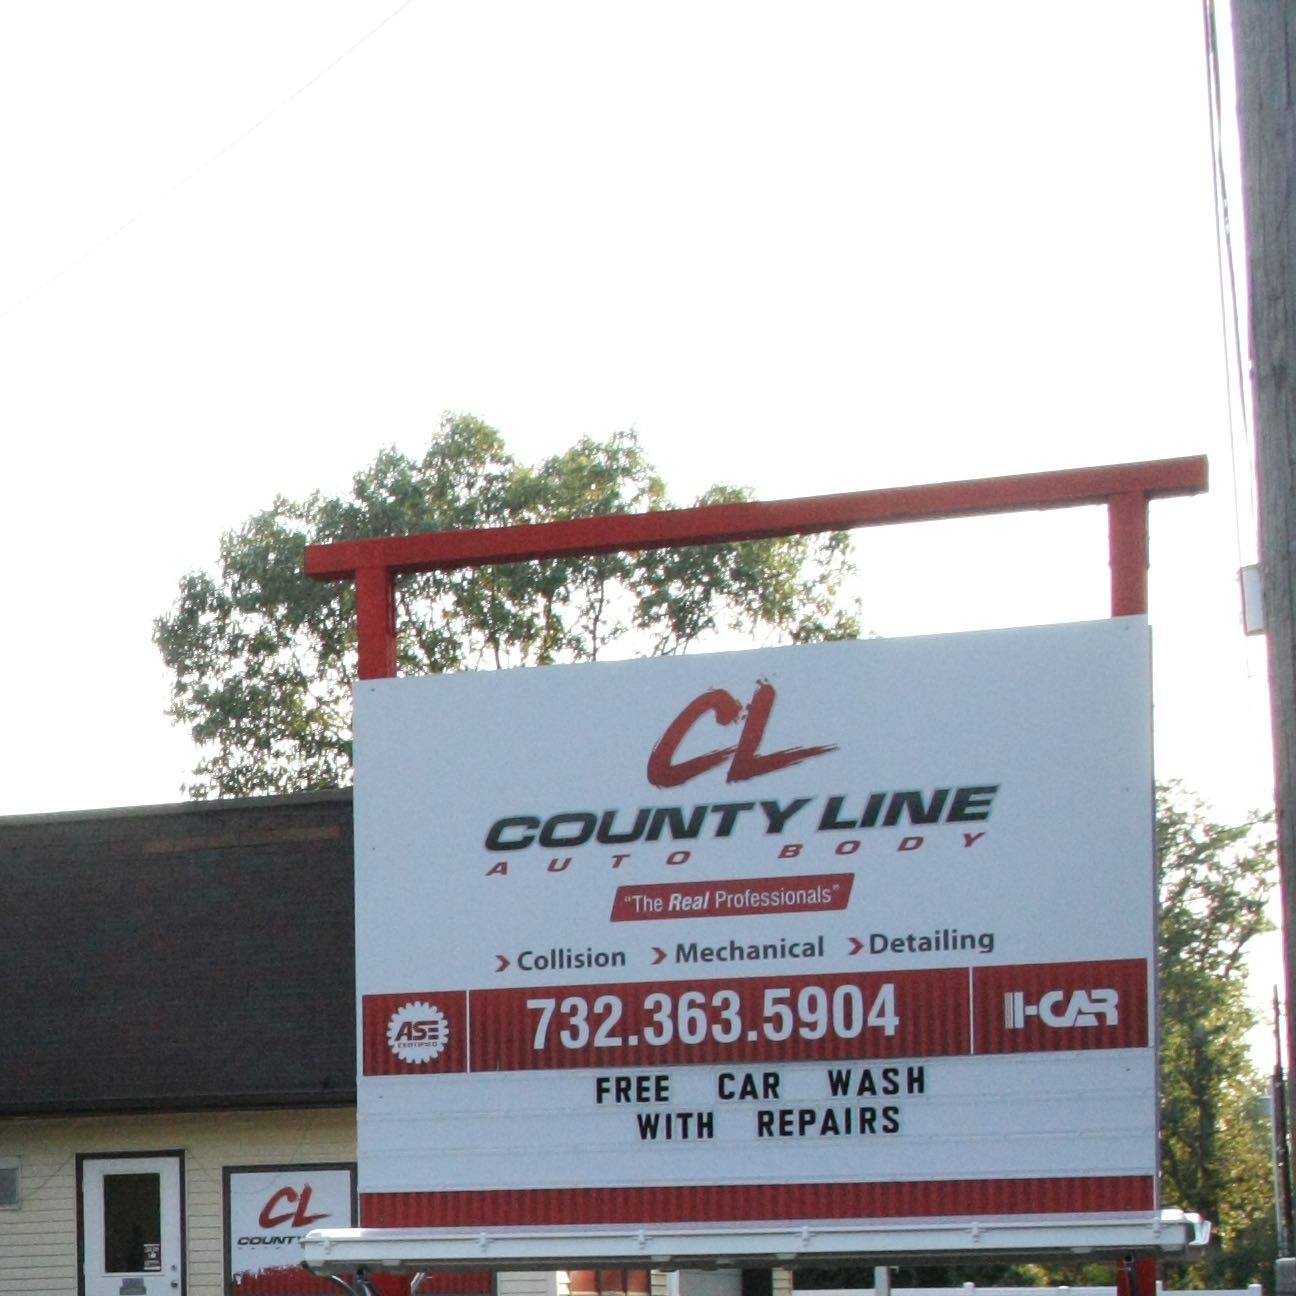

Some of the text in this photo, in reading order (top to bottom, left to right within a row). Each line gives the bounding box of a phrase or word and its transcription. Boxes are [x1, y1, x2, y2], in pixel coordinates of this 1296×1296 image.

[647, 677, 839, 789] CL
[485, 784, 1001, 853] COUNTY LINE
[485, 832, 985, 876] AUTO BODY
[668, 891, 710, 912] Real
[517, 928, 995, 973] Collision Mechanical Detailing
[394, 1020, 440, 1041] ASE
[527, 983, 900, 1050] 732.363.5904
[596, 1066, 926, 1105] FREE CAR WASH
[637, 1106, 901, 1140] WITH REPAIRS
[258, 1183, 332, 1229] CL
[237, 1235, 303, 1246] COUNT
